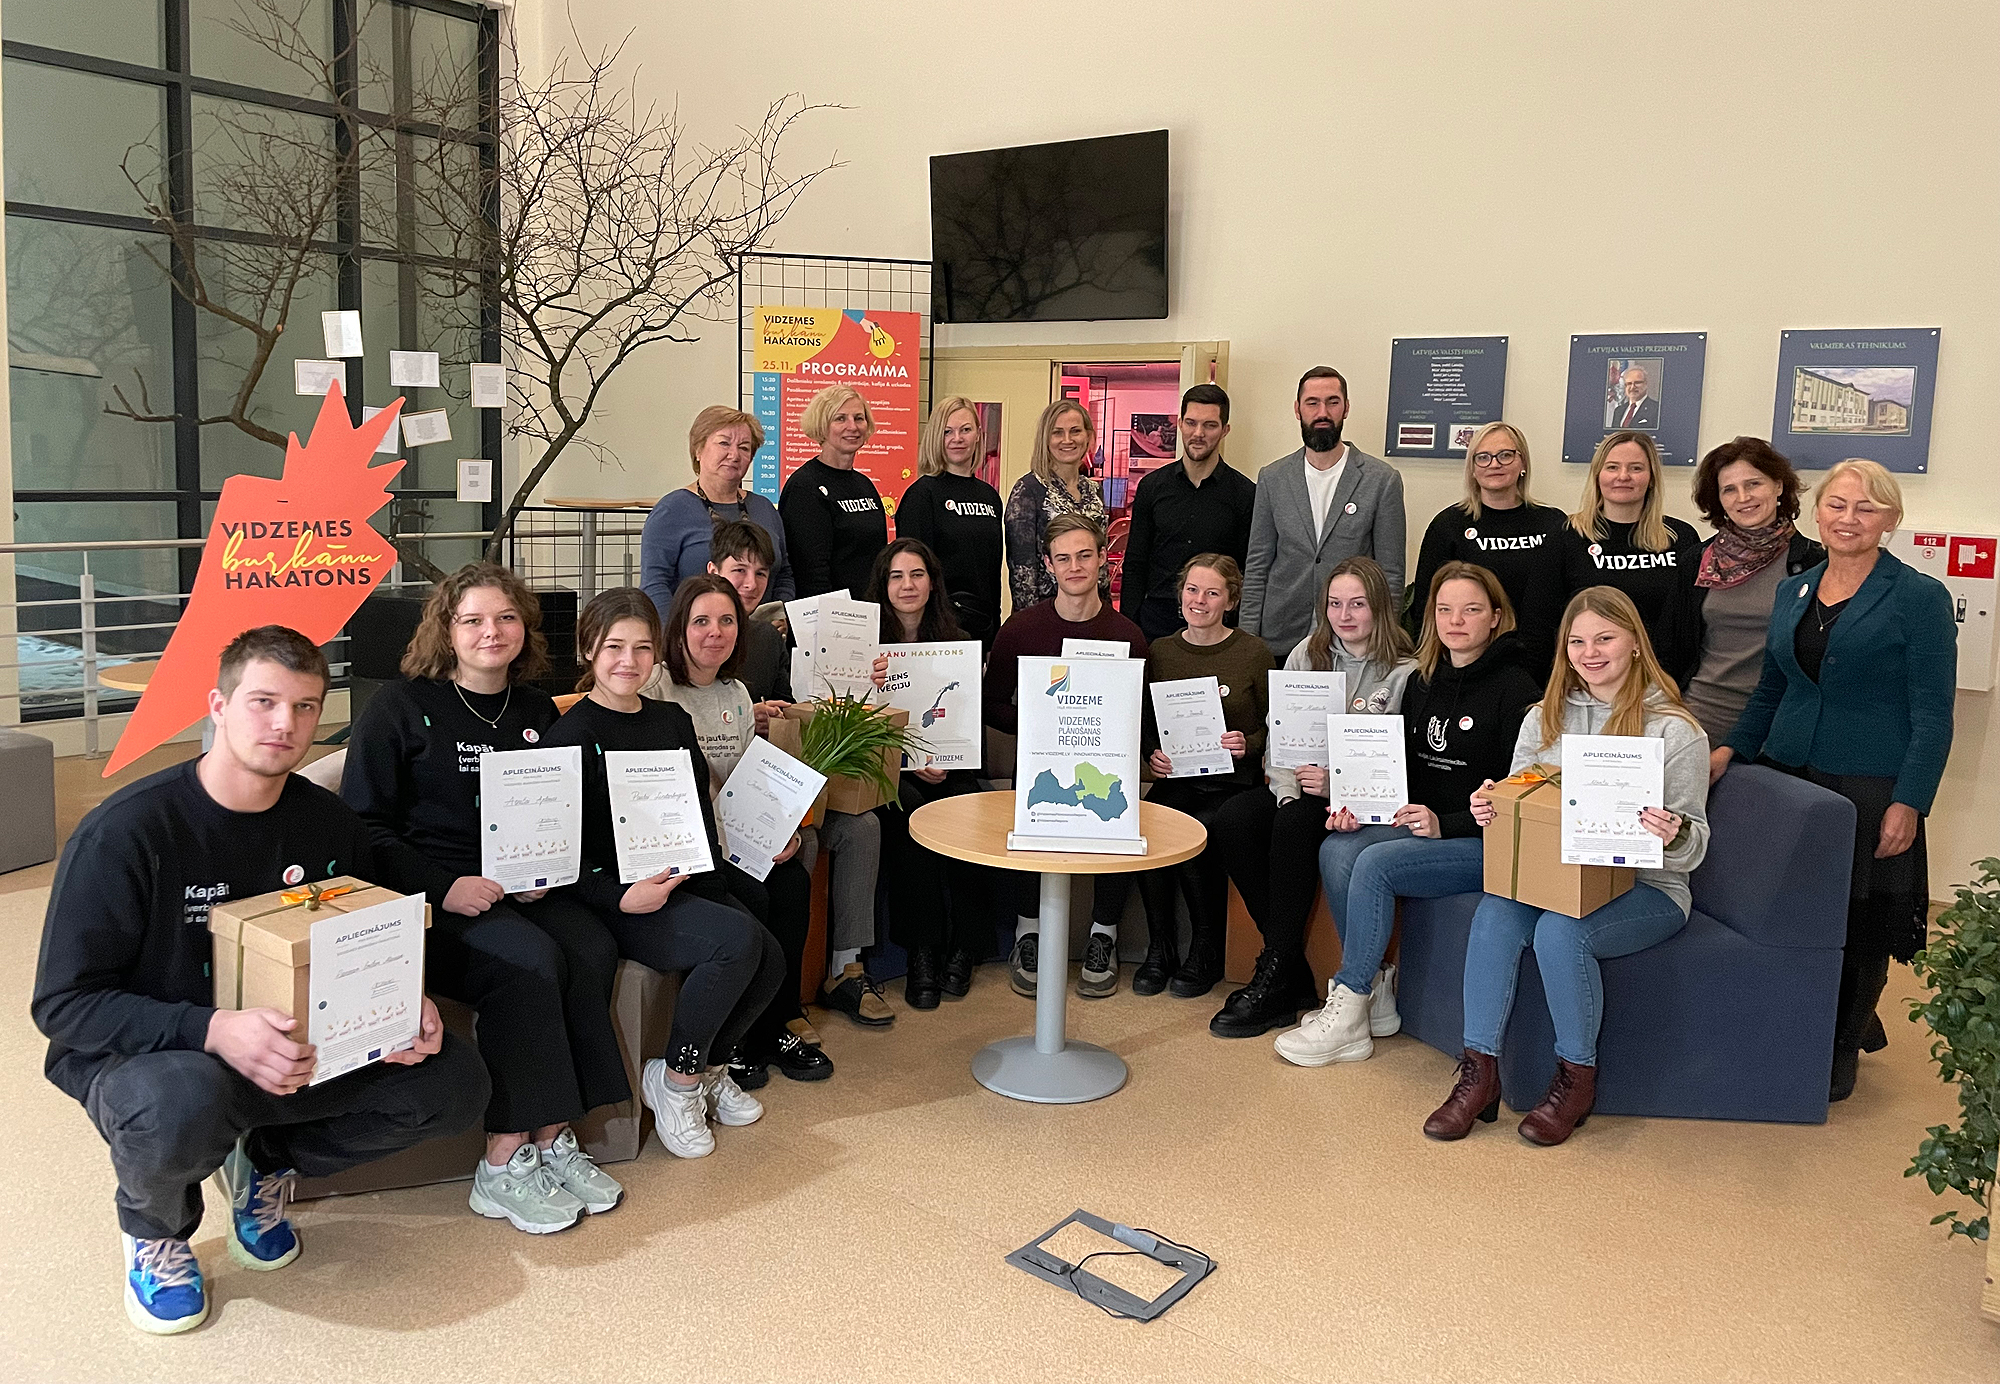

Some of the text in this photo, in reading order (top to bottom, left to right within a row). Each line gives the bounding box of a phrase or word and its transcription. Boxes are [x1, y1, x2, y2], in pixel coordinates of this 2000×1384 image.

[764, 315, 815, 325] VIDZEMES
[764, 337, 821, 346] HAKATONS
[1588, 346, 1619, 354] LATVIJAS
[1620, 345, 1644, 353] VALSTS
[762, 360, 793, 371] 25.11.
[802, 362, 908, 379] PROGRAMMA
[221, 520, 353, 539] VIDZEMES
[1476, 534, 1547, 551] VIDZEM
[1922, 537, 1937, 546] 112
[222, 530, 383, 577] burkānu
[1593, 552, 1677, 570] VIDZEME
[225, 568, 372, 590] HAKATONS
[911, 649, 964, 657] HAKATONS
[1057, 695, 1103, 706] VIDZEME
[1058, 716, 1102, 726] VIDZEMES
[1058, 726, 1102, 736] PLĀNOŠANAS
[456, 741, 495, 754] Kapāt
[1058, 735, 1102, 749] REĢIONS
[1583, 752, 1643, 761] APLIECINĀJUMS
[503, 765, 562, 776] APLIECINĀJUMS
[625, 766, 676, 774] APLIECINĀJUMS
[760, 758, 804, 788] APLIECINĀJUMS
[335, 919, 402, 945] APLIECINĀJUMS
